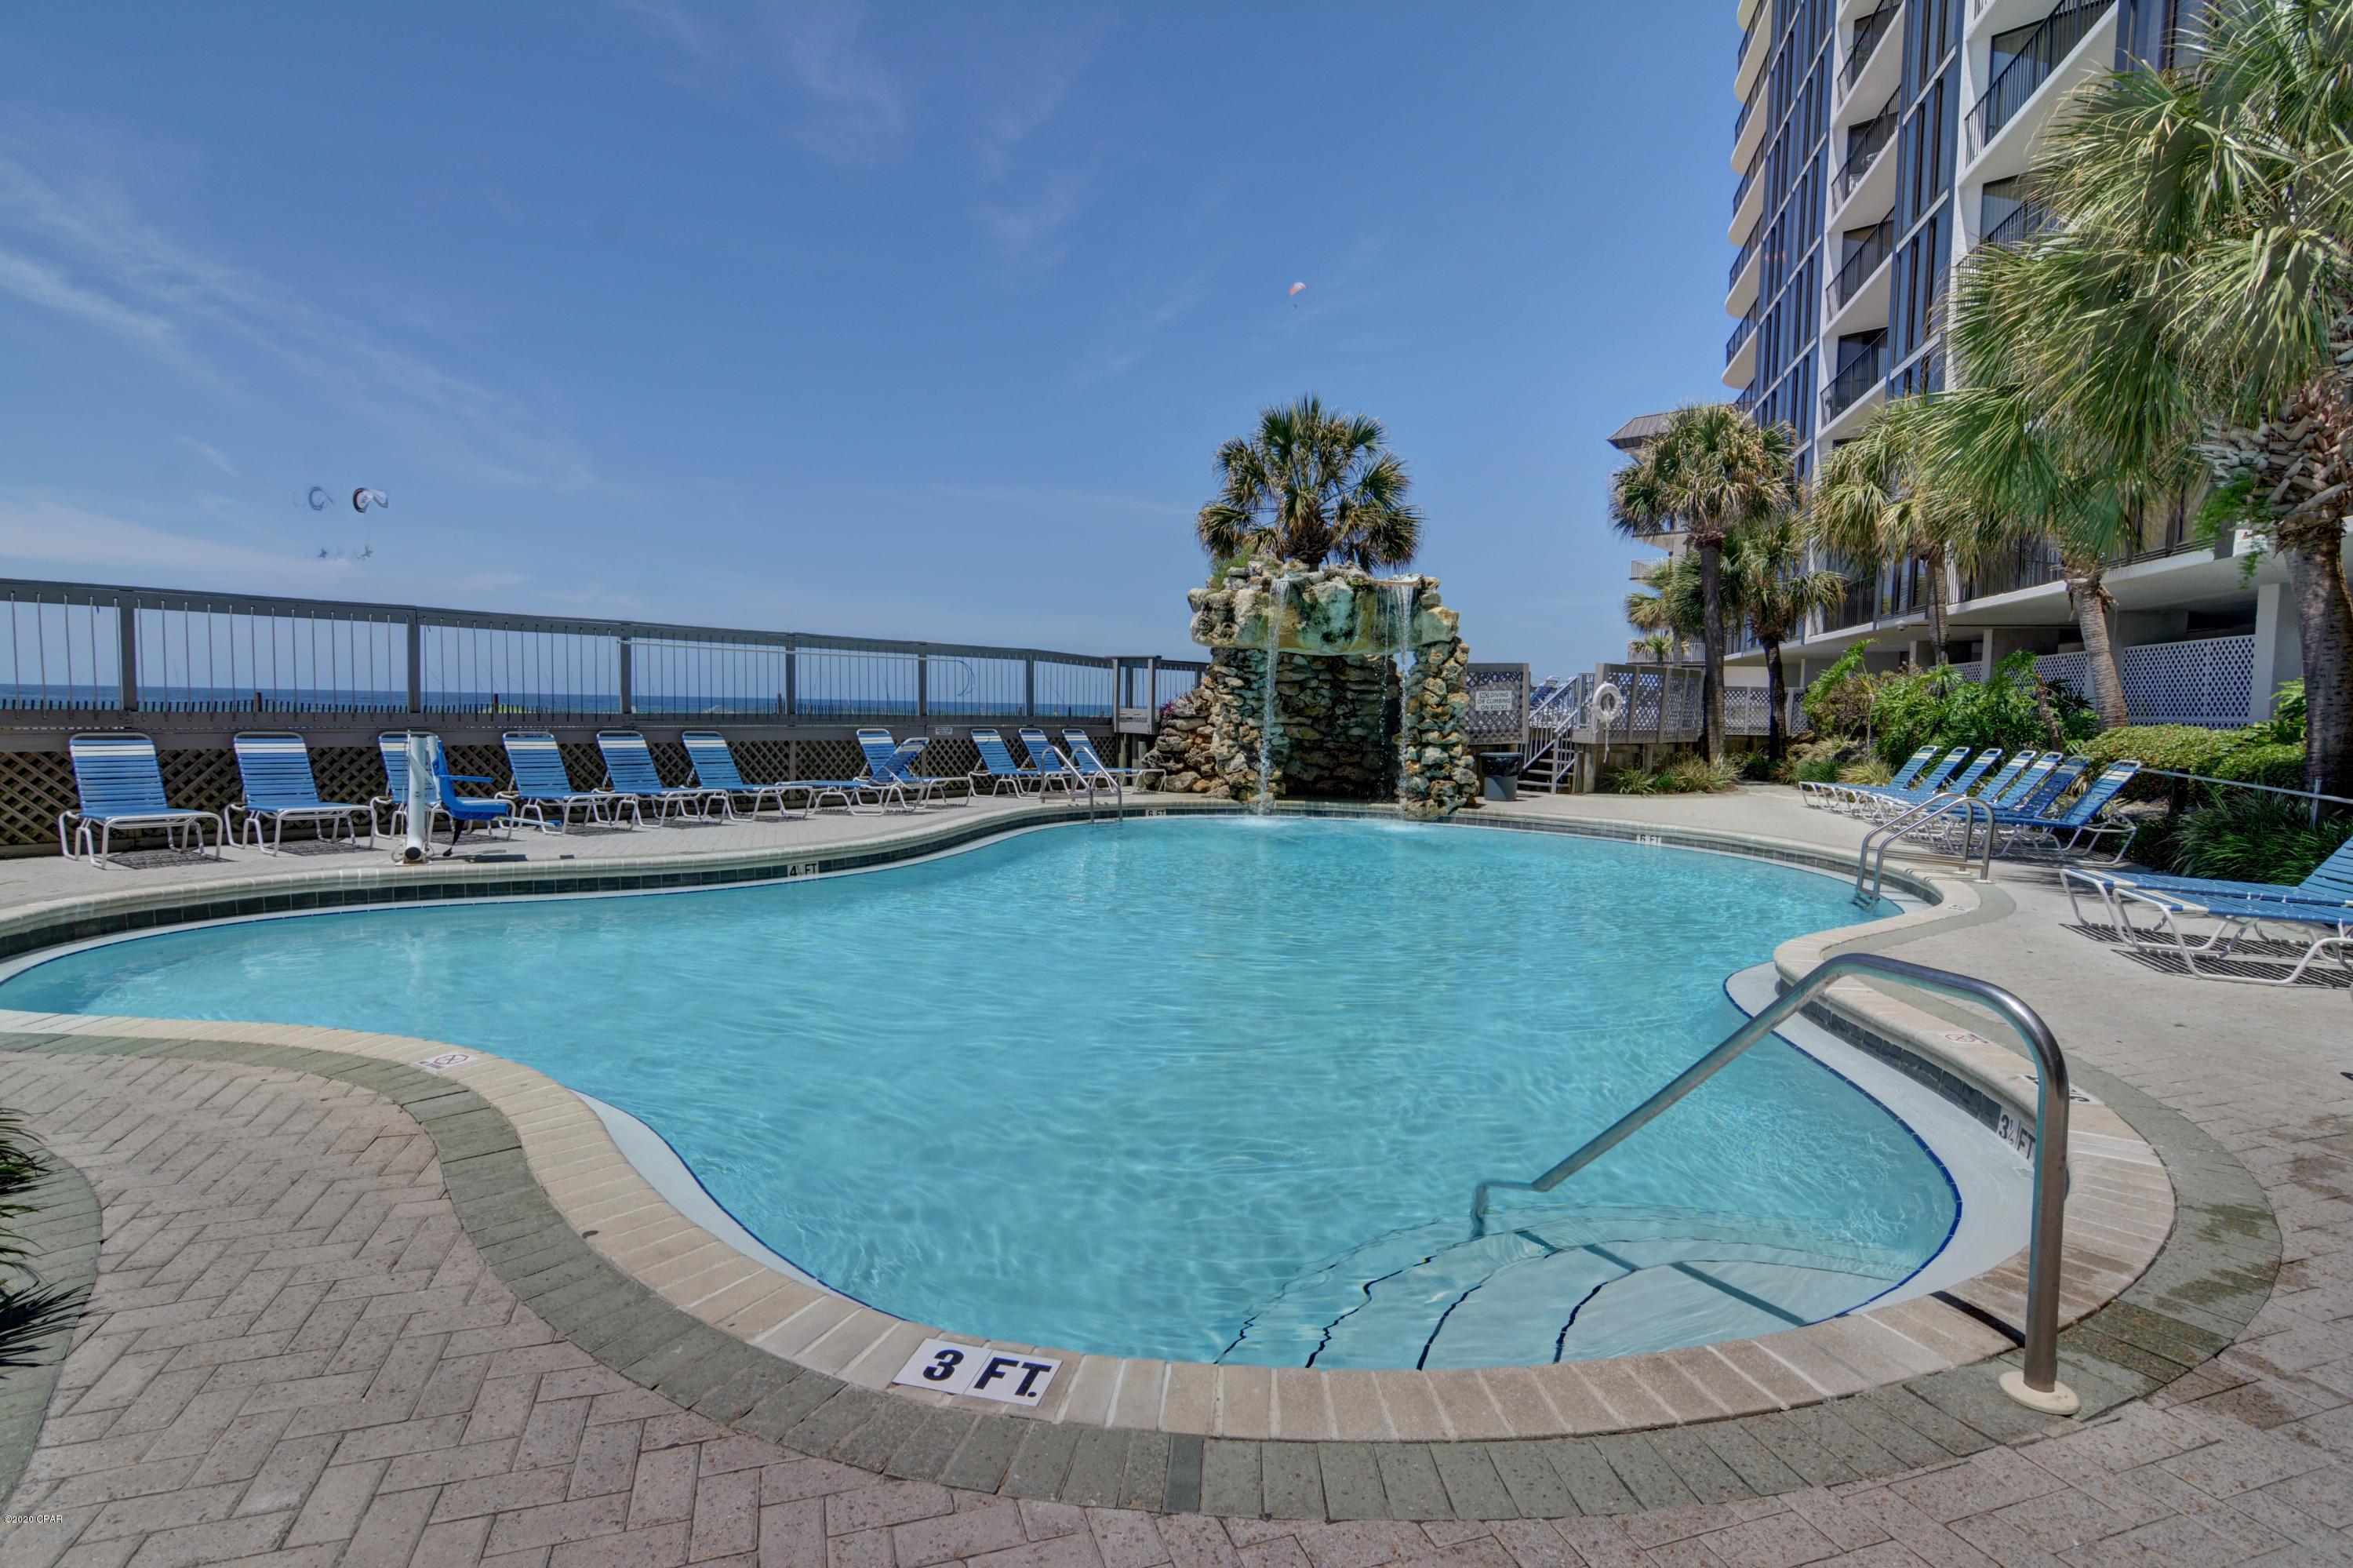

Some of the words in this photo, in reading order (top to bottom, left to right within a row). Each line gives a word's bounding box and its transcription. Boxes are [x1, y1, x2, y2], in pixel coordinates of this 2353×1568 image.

[1649, 834, 1660, 843] FT
[805, 863, 816, 875] FT
[2017, 1127, 2036, 1160] FT
[922, 1349, 964, 1381] 3
[973, 1357, 1053, 1397] FT.
